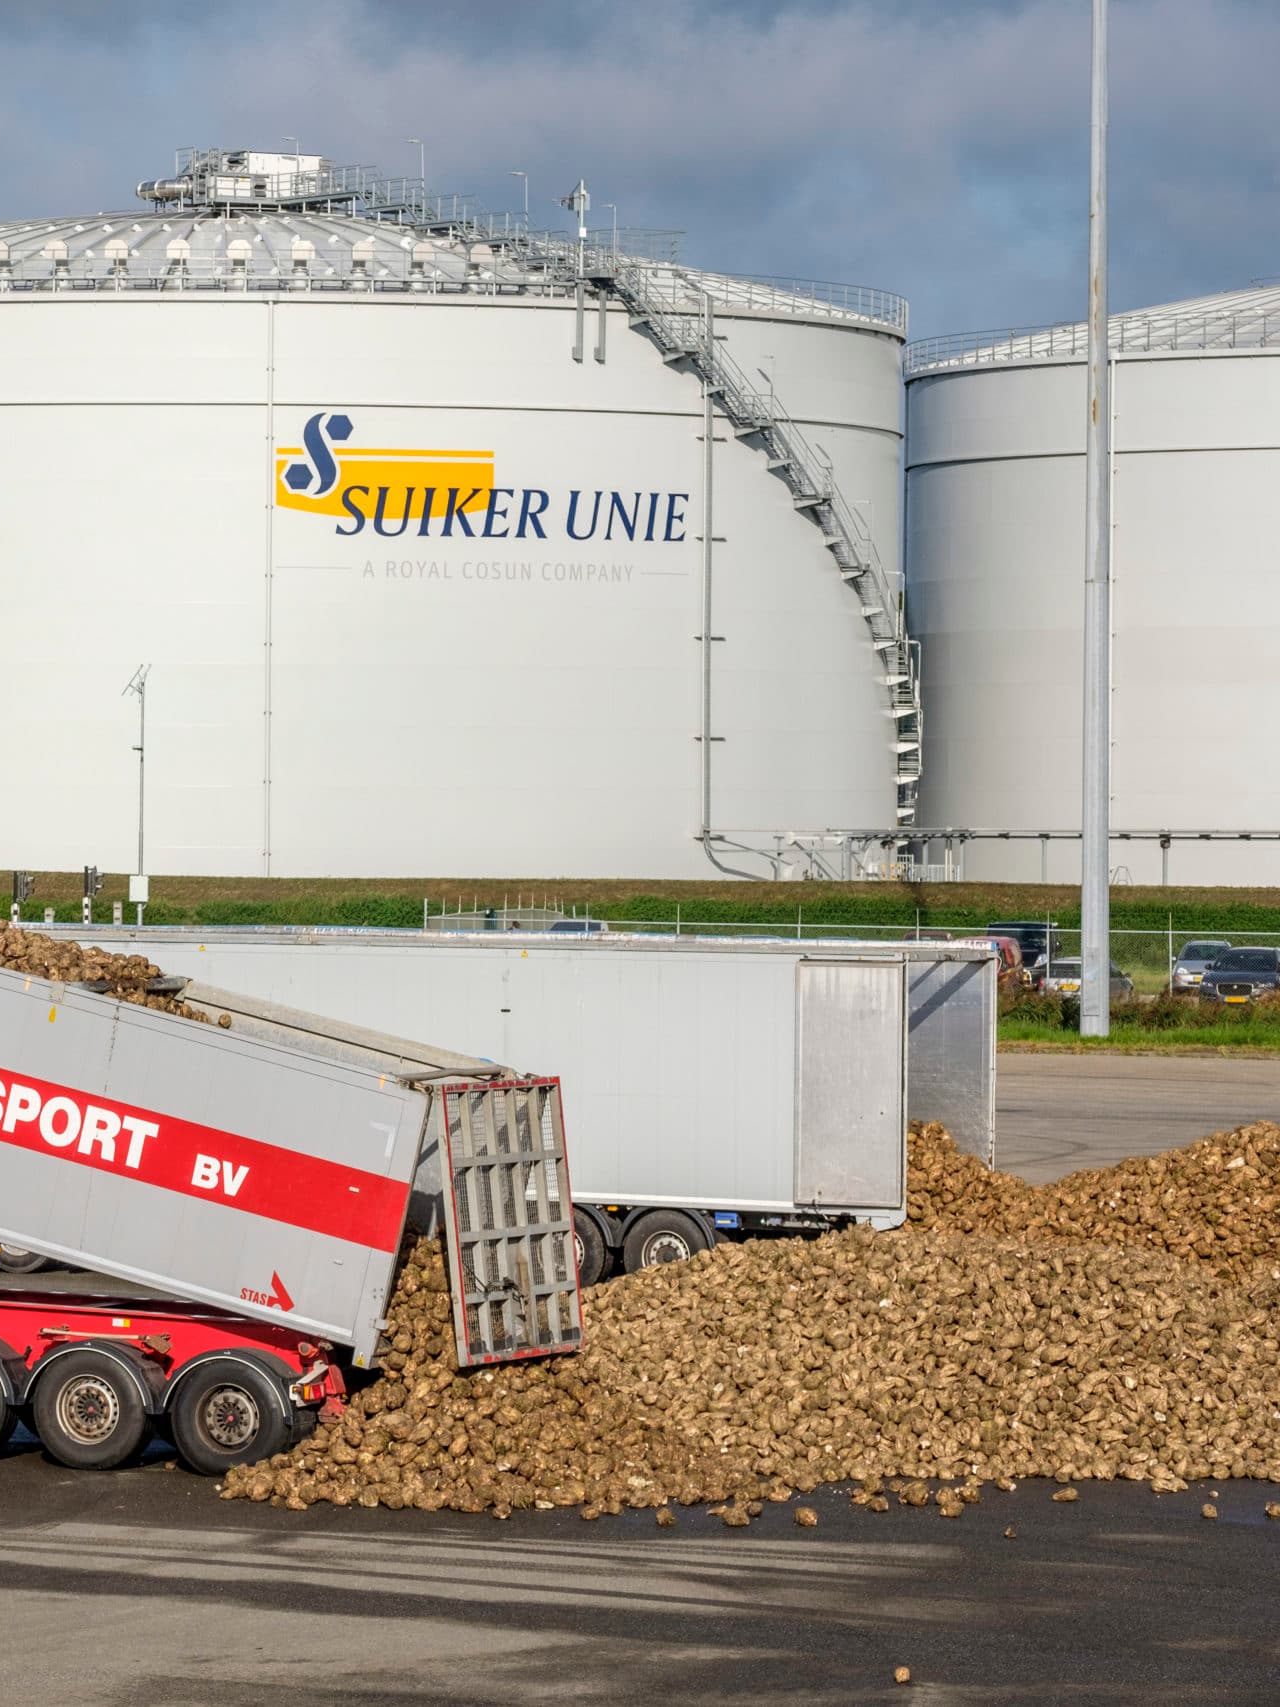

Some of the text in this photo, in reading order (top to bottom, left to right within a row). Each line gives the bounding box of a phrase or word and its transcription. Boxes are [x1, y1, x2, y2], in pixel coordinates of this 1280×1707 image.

[335, 485, 690, 543] SUIKER UNIE
[362, 560, 634, 583] A ROYAL COSUN COMPANY
[191, 1153, 250, 1197] BV
[239, 1288, 267, 1305] STAS
